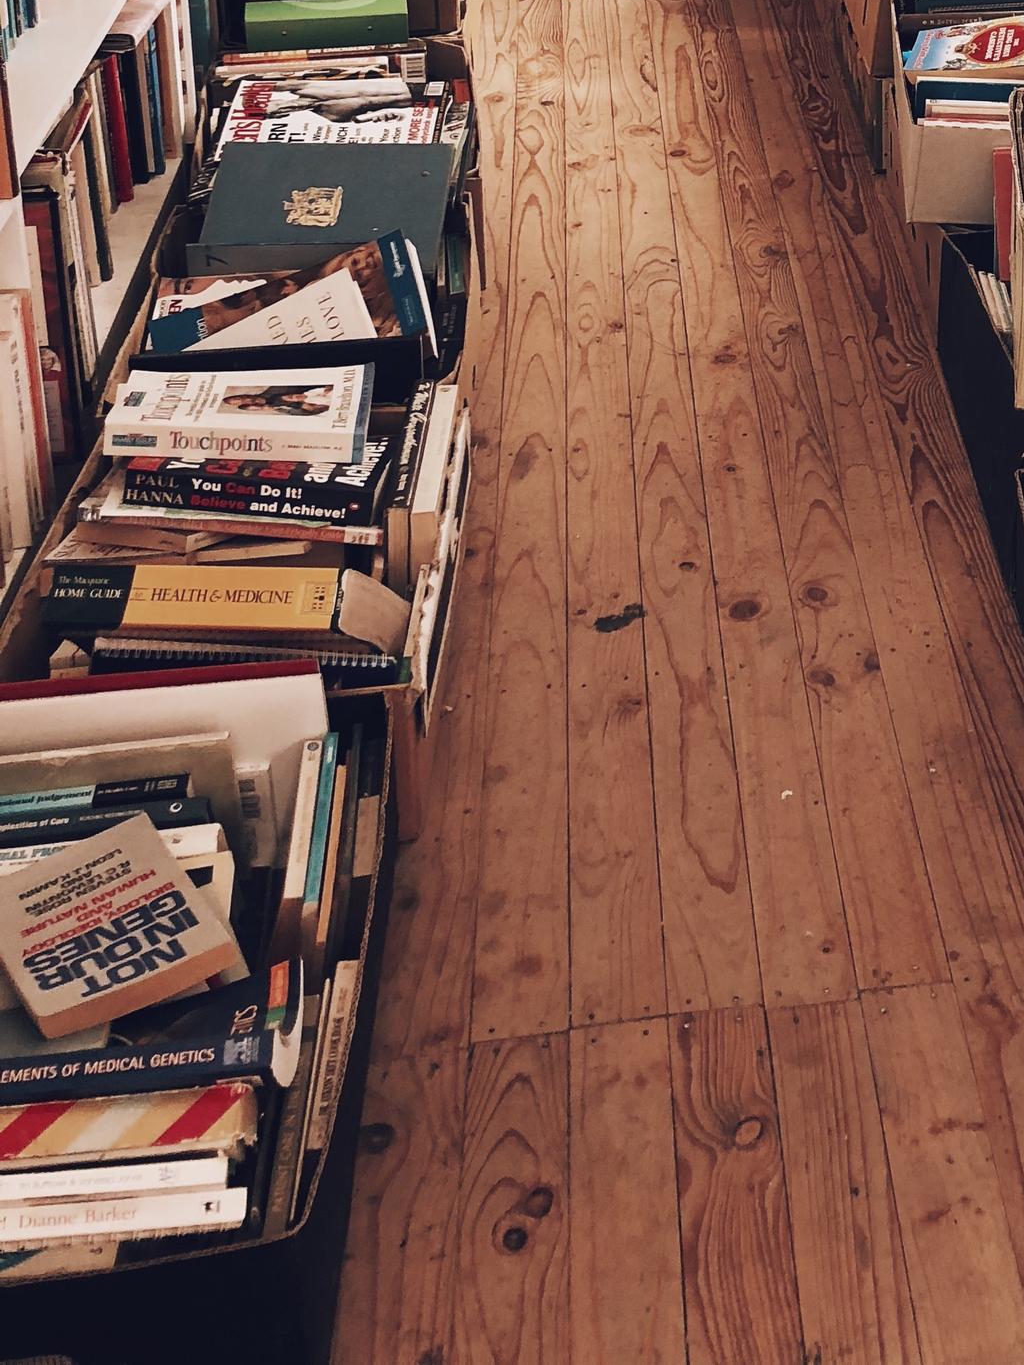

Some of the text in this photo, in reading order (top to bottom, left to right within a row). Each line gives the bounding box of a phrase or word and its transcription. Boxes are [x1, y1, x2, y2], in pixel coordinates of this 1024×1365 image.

[169, 430, 273, 455] Touchpoints
[135, 473, 180, 489] PAUL
[191, 478, 223, 493] You
[225, 482, 256, 496] Can
[260, 484, 282, 497] Do
[125, 488, 184, 505] HANNA
[190, 495, 347, 520] Believe and Achieve!
[53, 587, 294, 604] HOME GUIDE HEALTH MEDICINE
[19, 867, 157, 938] HUMAN NATURE
[77, 899, 113, 923] AND
[21, 917, 104, 957] IDEOLOGY
[23, 889, 187, 974] GENES
[33, 906, 200, 992] IN OUR
[80, 938, 188, 998] NOT
[60, 1046, 215, 1078] OF MEDICAL GENETICS
[82, 1204, 139, 1224] Barker
